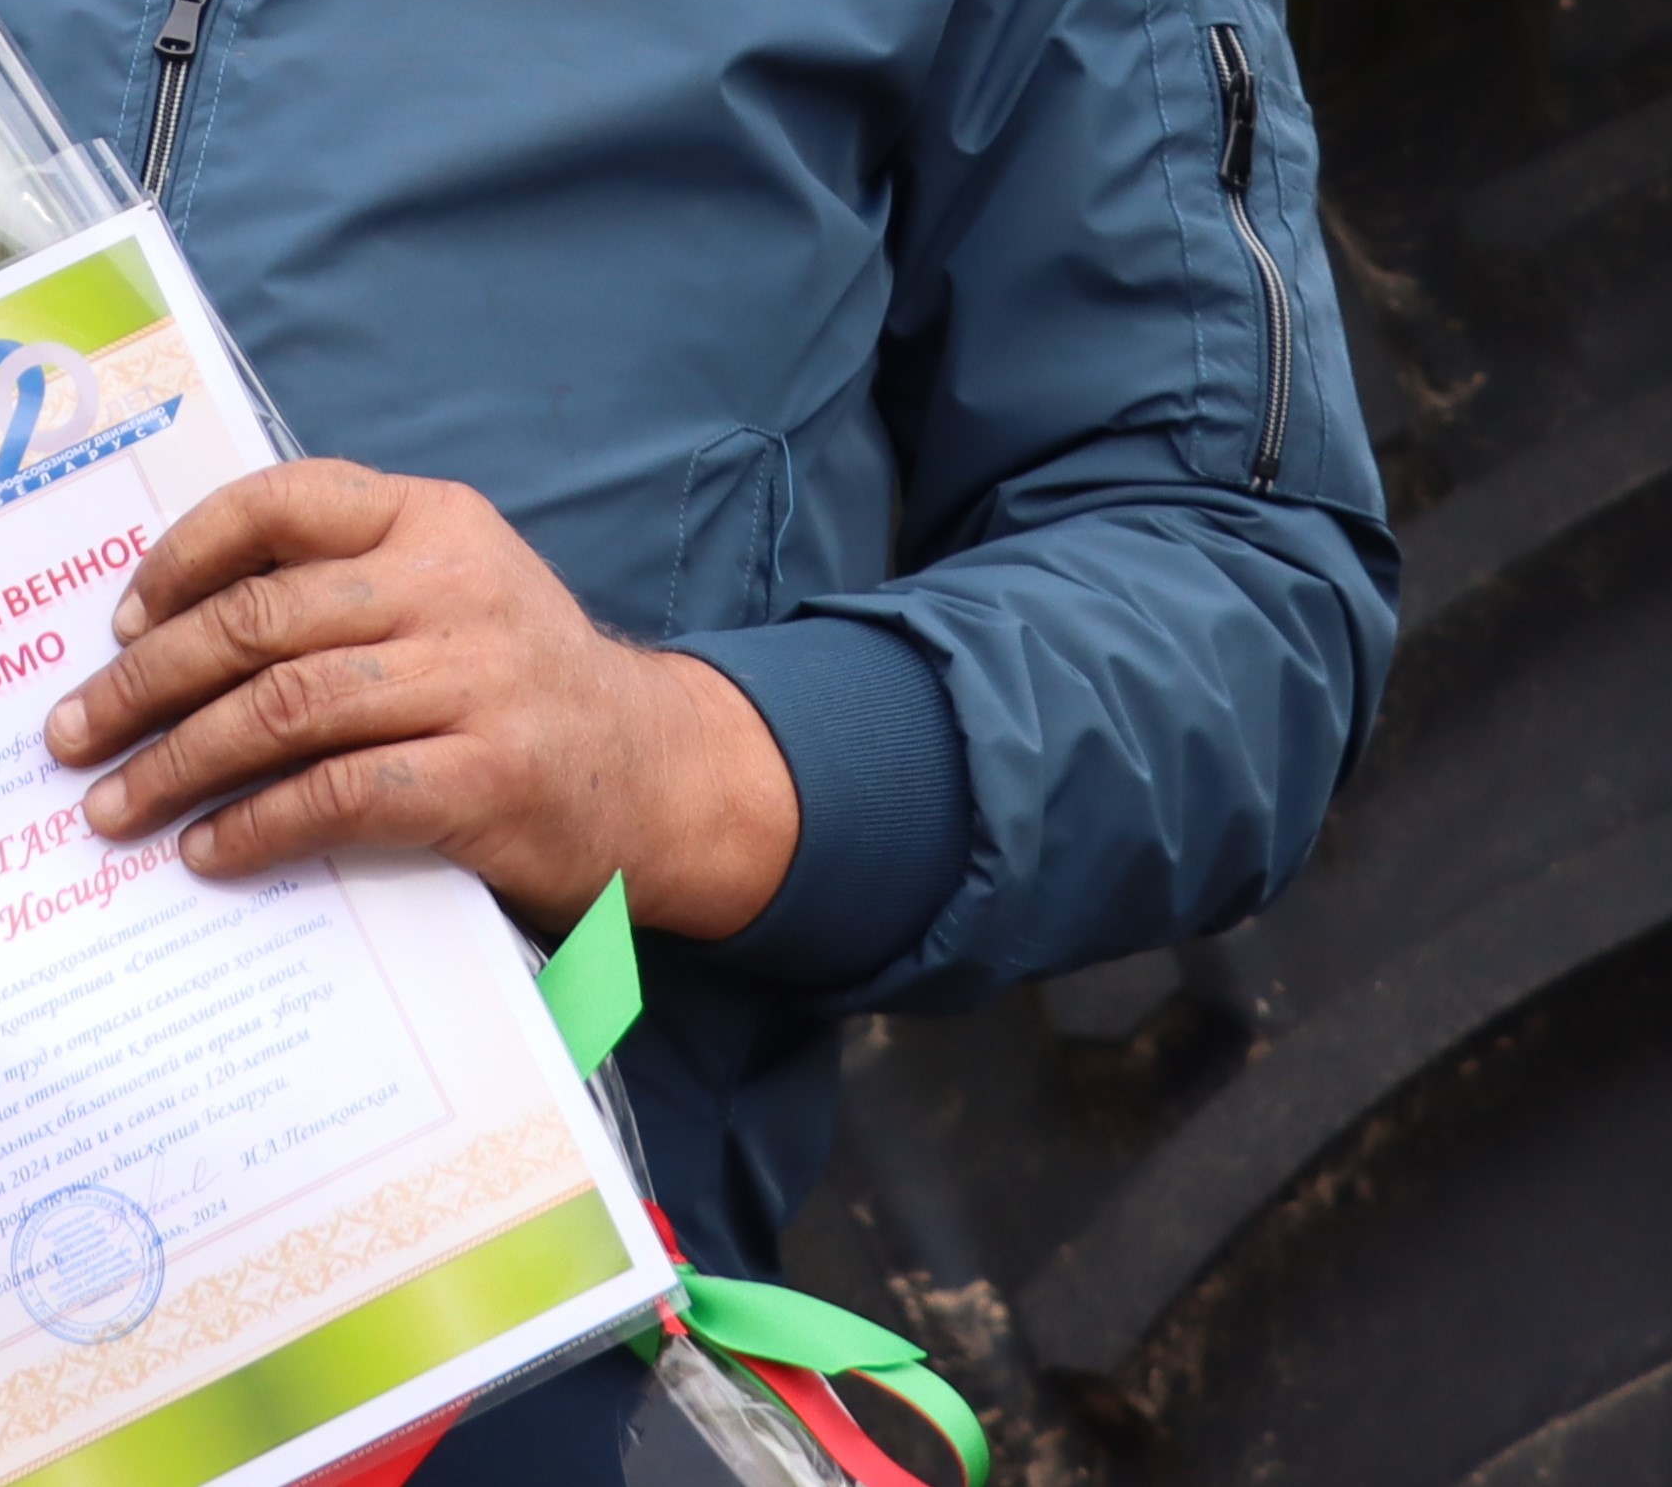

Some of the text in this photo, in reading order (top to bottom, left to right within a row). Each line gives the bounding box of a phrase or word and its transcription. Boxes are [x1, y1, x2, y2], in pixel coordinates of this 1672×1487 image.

[91, 403, 167, 449] ДВИЖЕНИЮ
[37, 753, 60, 784] ра
[1, 1046, 48, 1083] труд
[52, 1043, 63, 1059] в
[65, 1003, 144, 1052] отрасли
[145, 960, 230, 1013] сельского
[232, 912, 333, 970] хозяйства,
[23, 1048, 123, 1109] отношение
[125, 1039, 148, 1058] к
[142, 983, 255, 1050] выполнению
[257, 957, 312, 992] своих
[55, 1055, 181, 1129] обязанностей
[182, 1044, 204, 1065] во
[206, 1015, 263, 1055] время
[270, 980, 334, 1029] уборки
[8, 1153, 51, 1190] 2024
[55, 1136, 94, 1166] года
[96, 1128, 110, 1144] и
[112, 1121, 124, 1136] в
[126, 1094, 177, 1129] связи
[179, 1081, 200, 1102] со
[204, 1027, 312, 1090] 120-летием
[111, 1118, 200, 1173] движения
[191, 1197, 228, 1228] 2024
